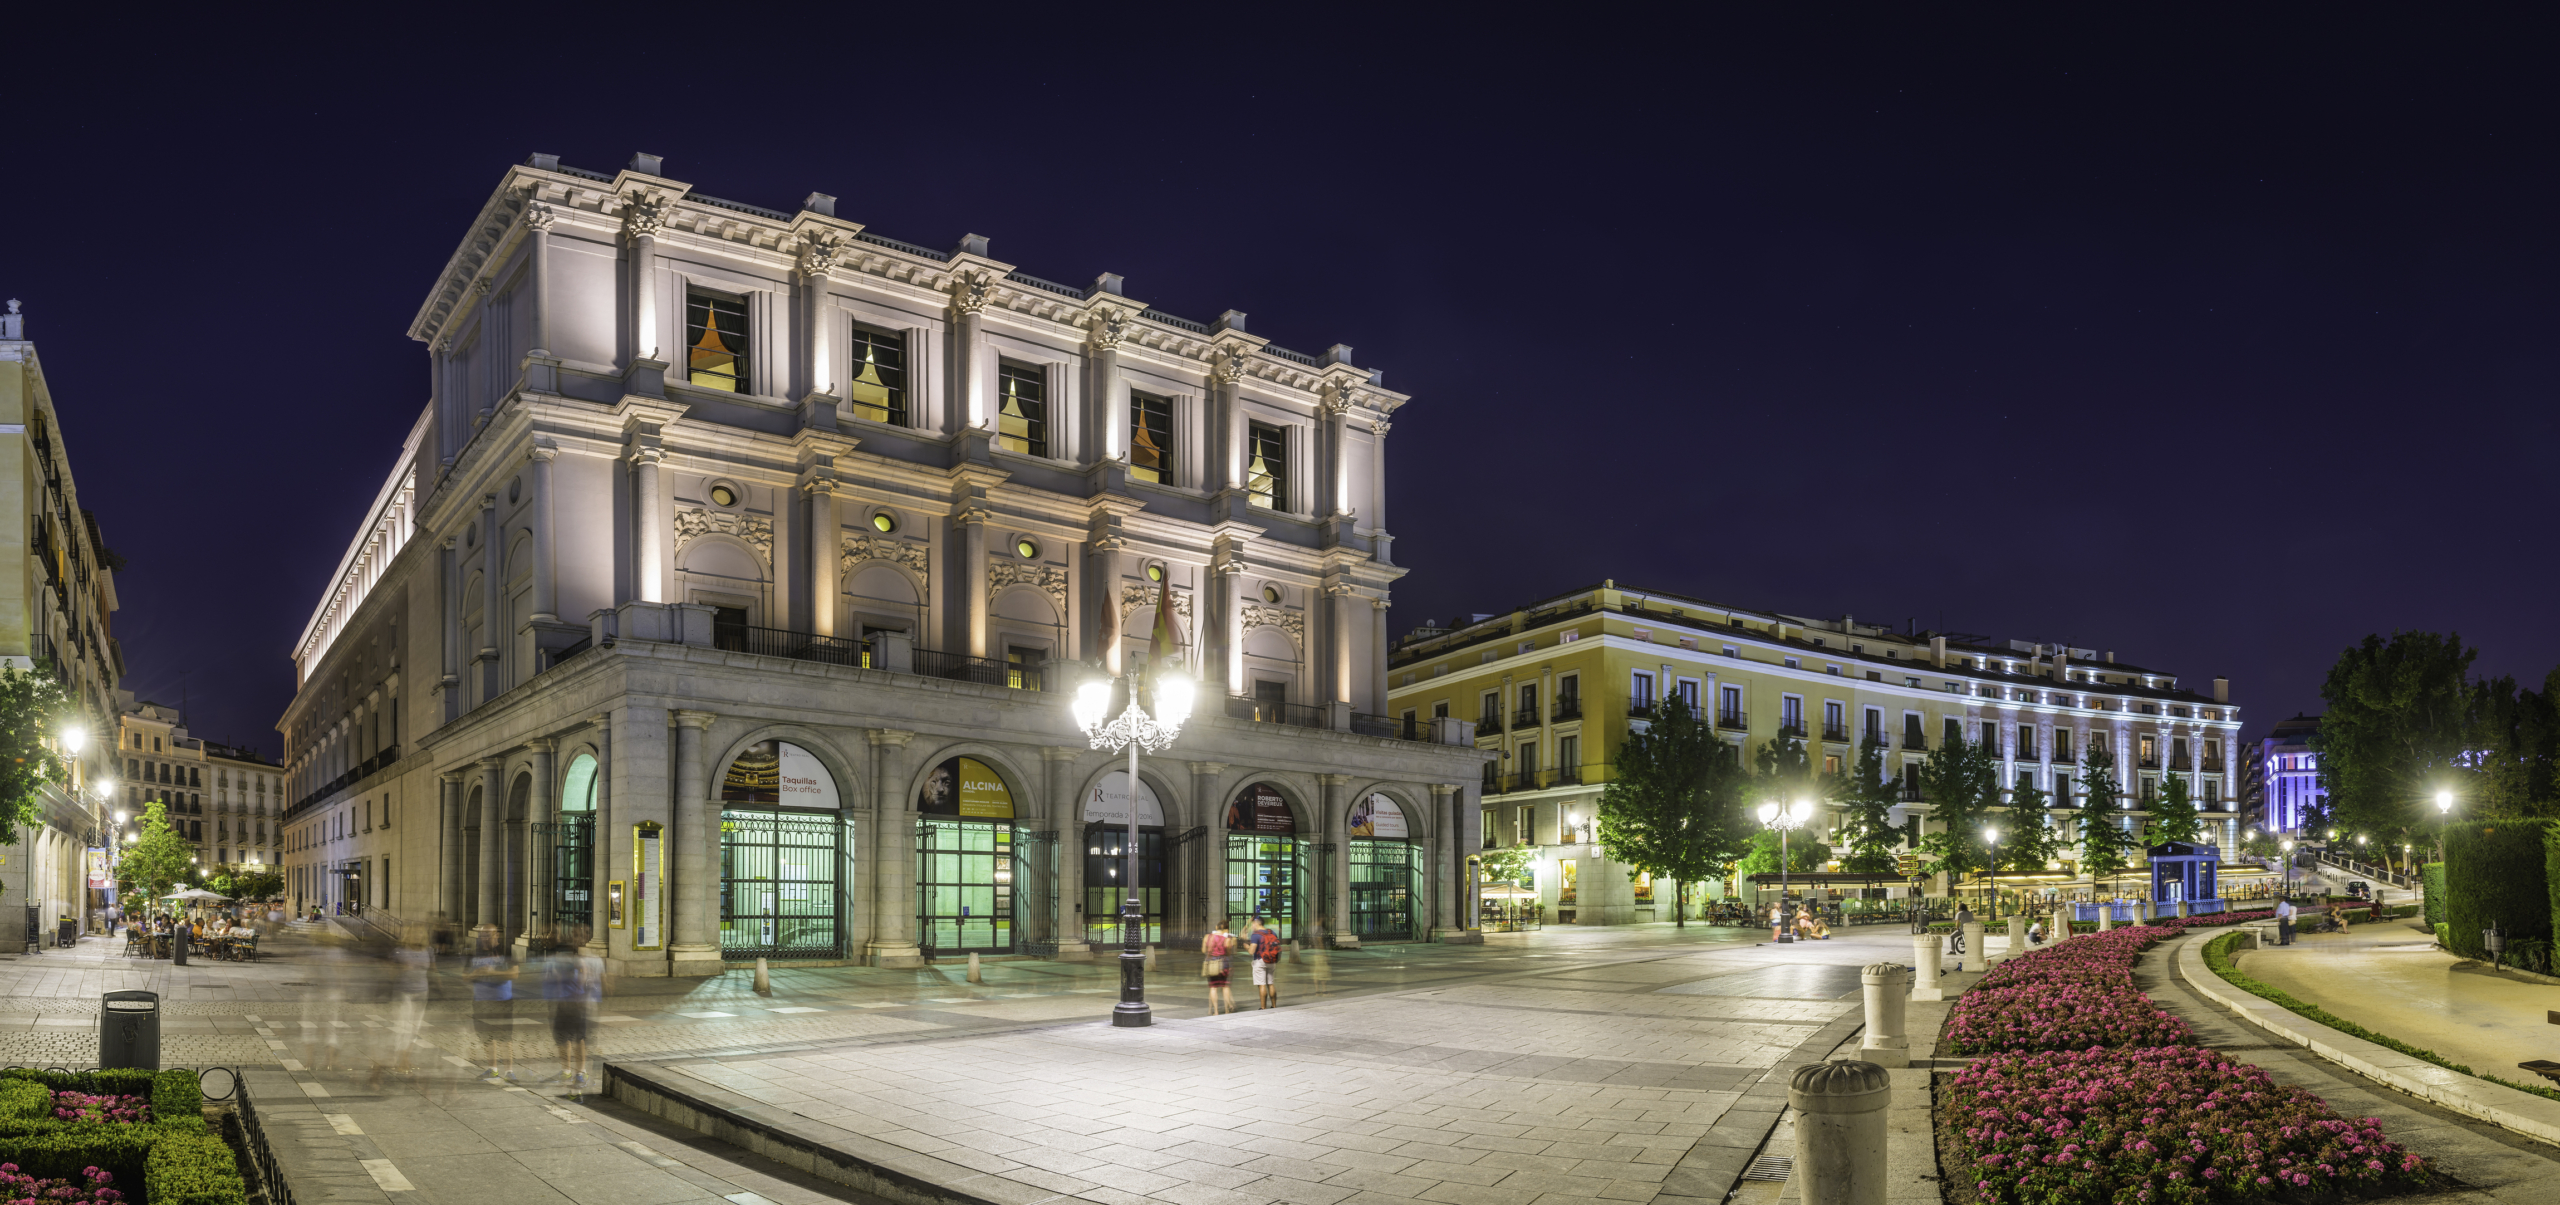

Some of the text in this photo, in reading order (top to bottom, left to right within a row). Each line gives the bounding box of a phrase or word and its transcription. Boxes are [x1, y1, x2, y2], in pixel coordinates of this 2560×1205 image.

[782, 776, 817, 785] Taquillas
[799, 786, 822, 794] office
[963, 781, 1004, 792] ALCINA
[1086, 810, 1123, 818] Temporada
